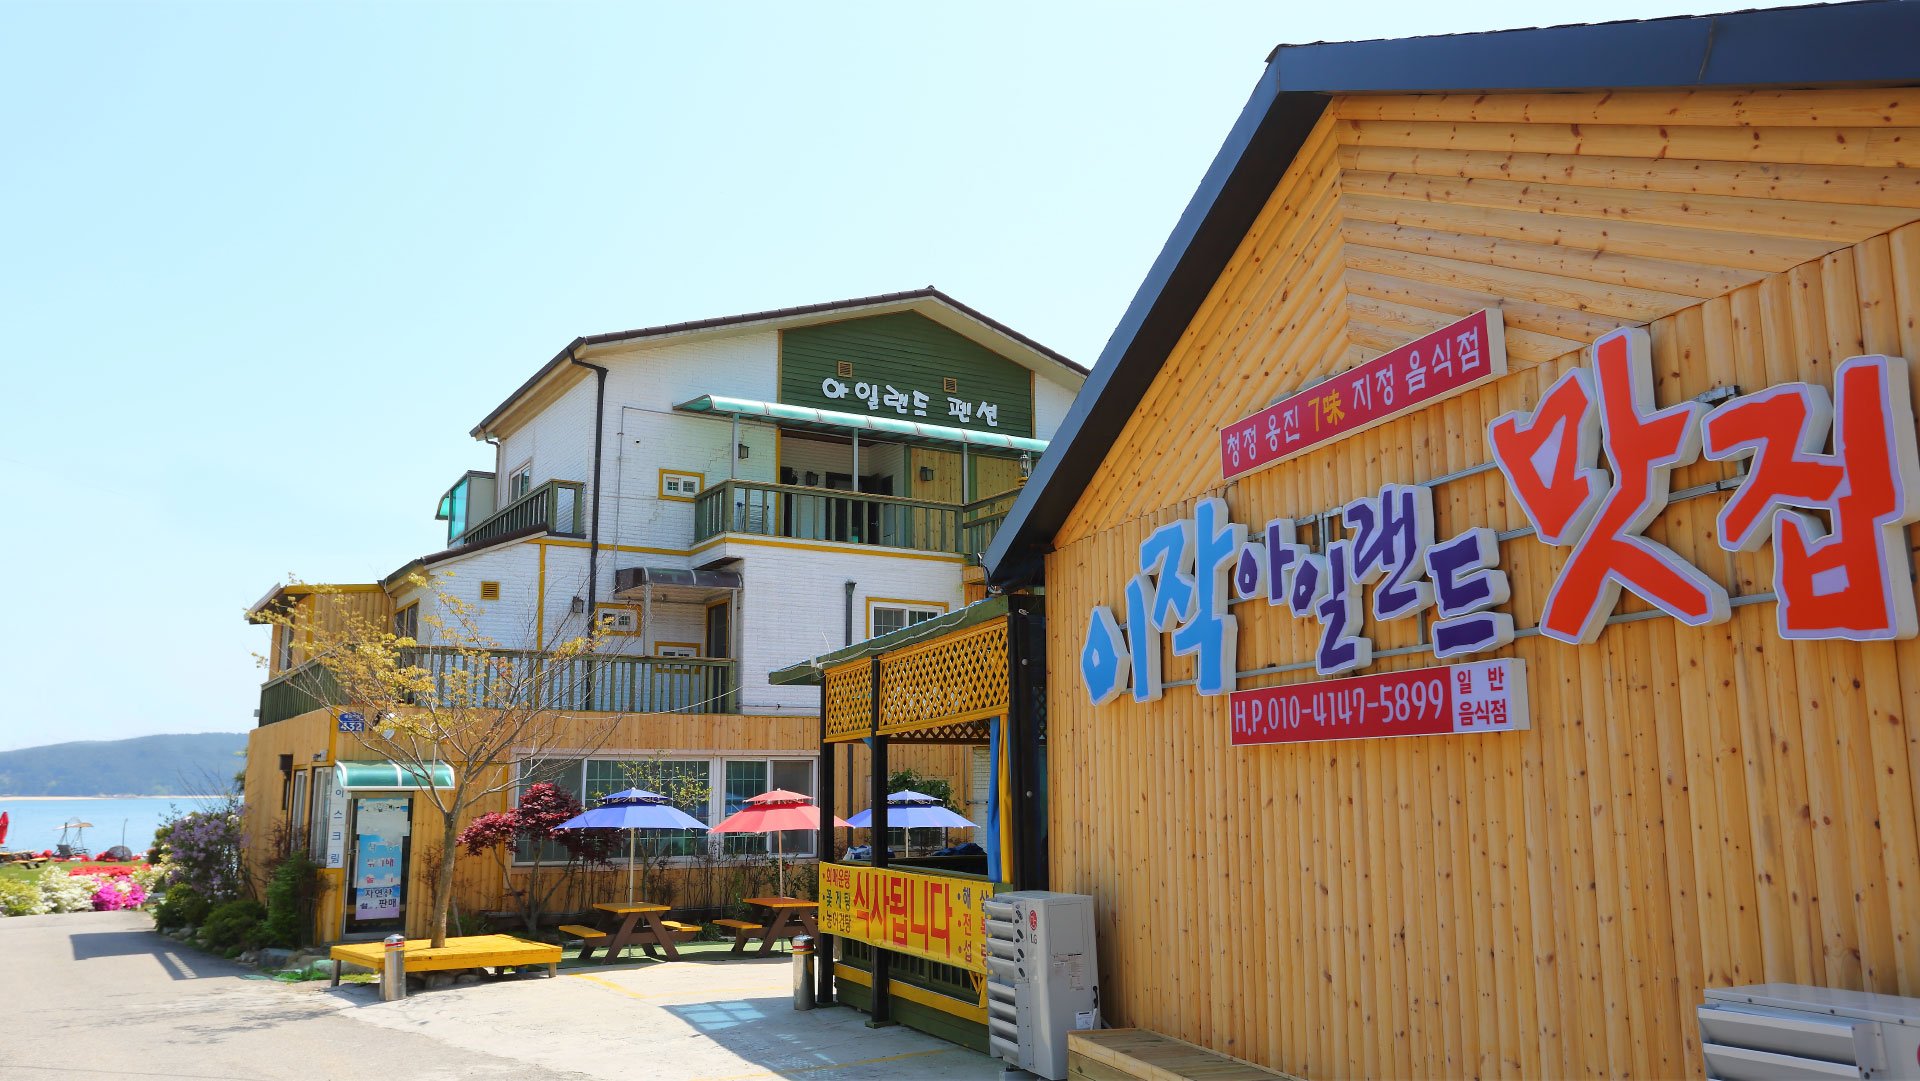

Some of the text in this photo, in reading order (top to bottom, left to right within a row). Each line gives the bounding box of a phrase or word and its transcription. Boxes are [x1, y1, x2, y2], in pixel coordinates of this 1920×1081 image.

[822, 377, 998, 427] 아일랜드 펜션
[1227, 326, 1480, 468] 청정 옹진 7味 지정 음식점
[1081, 327, 1905, 705] 이작 아일랜드 맛집
[1459, 698, 1507, 726] 음식점
[331, 773, 345, 864] 이스크림
[379, 898, 397, 909] 판매
[853, 871, 952, 958] 식사됩니다
[1030, 933, 1038, 945] LG
